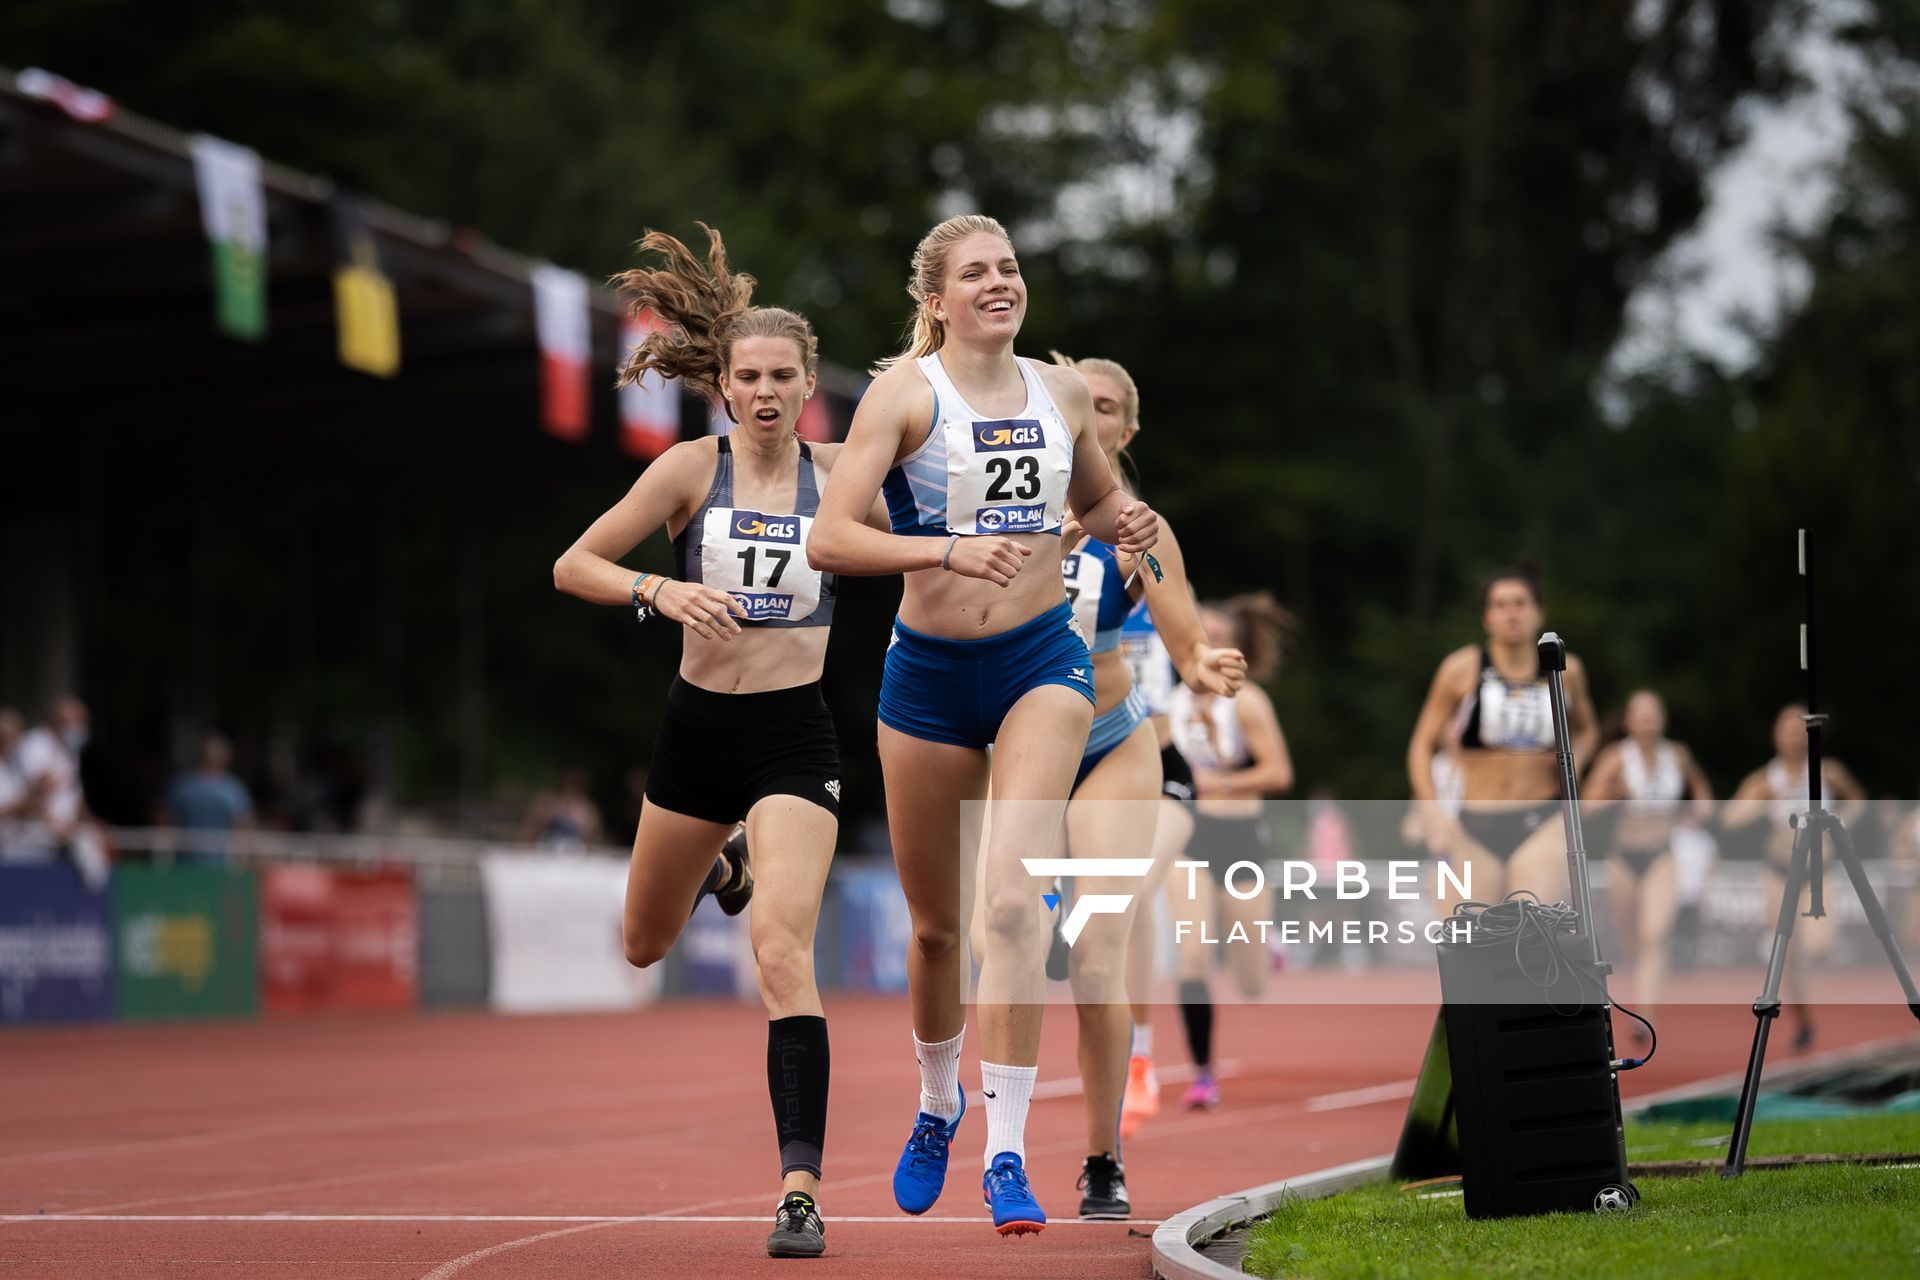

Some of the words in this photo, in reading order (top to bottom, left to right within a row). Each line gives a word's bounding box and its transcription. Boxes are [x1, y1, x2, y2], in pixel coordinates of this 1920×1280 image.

[1012, 427, 1039, 444] GLS
[985, 455, 1041, 501] 23
[1008, 508, 1043, 523] PLAN
[766, 523, 795, 538] GLS
[737, 546, 791, 588] 17
[754, 597, 790, 610] PLAN
